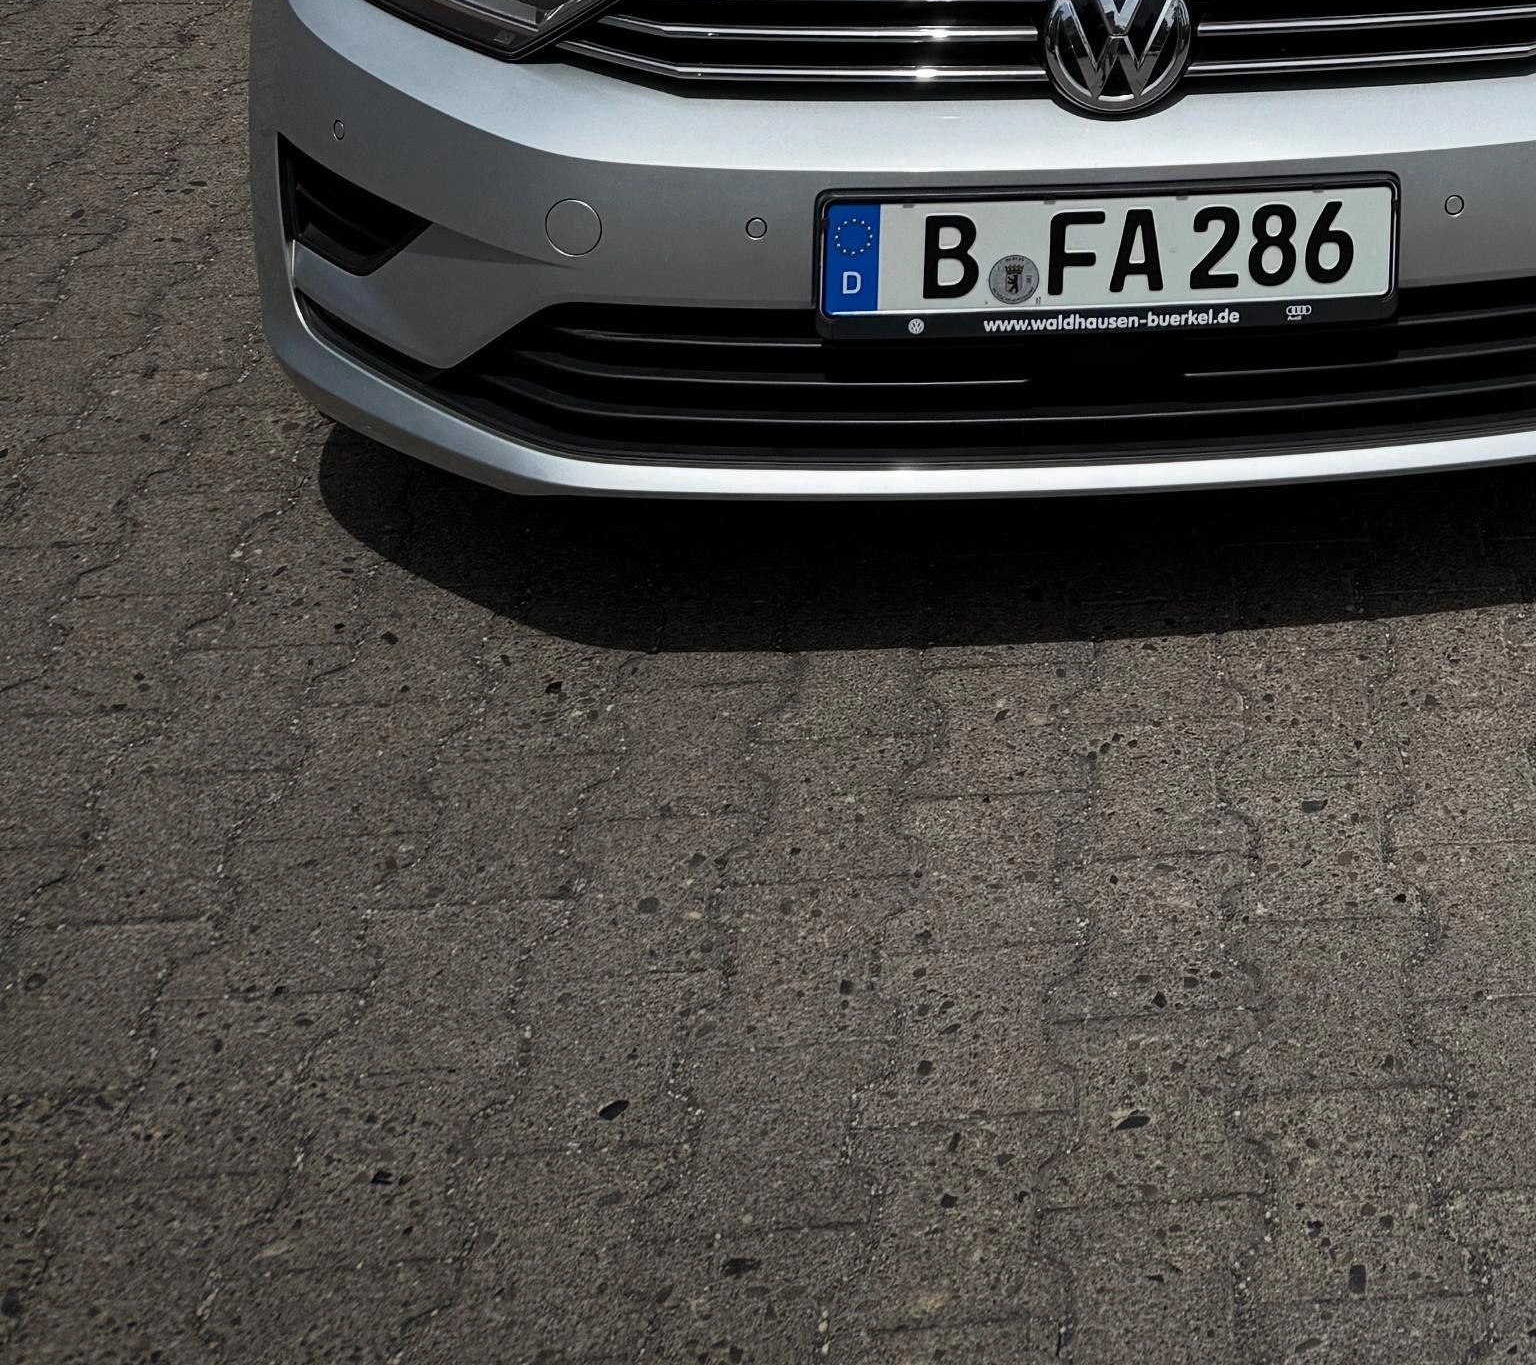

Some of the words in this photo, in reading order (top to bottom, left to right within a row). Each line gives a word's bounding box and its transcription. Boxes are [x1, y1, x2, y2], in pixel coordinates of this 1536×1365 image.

[923, 214, 979, 299] B
[1048, 209, 1163, 296] FA
[1190, 201, 1354, 290] 286
[842, 271, 862, 294] D
[984, 307, 1240, 332] www.waldhausen-buerkel.de
